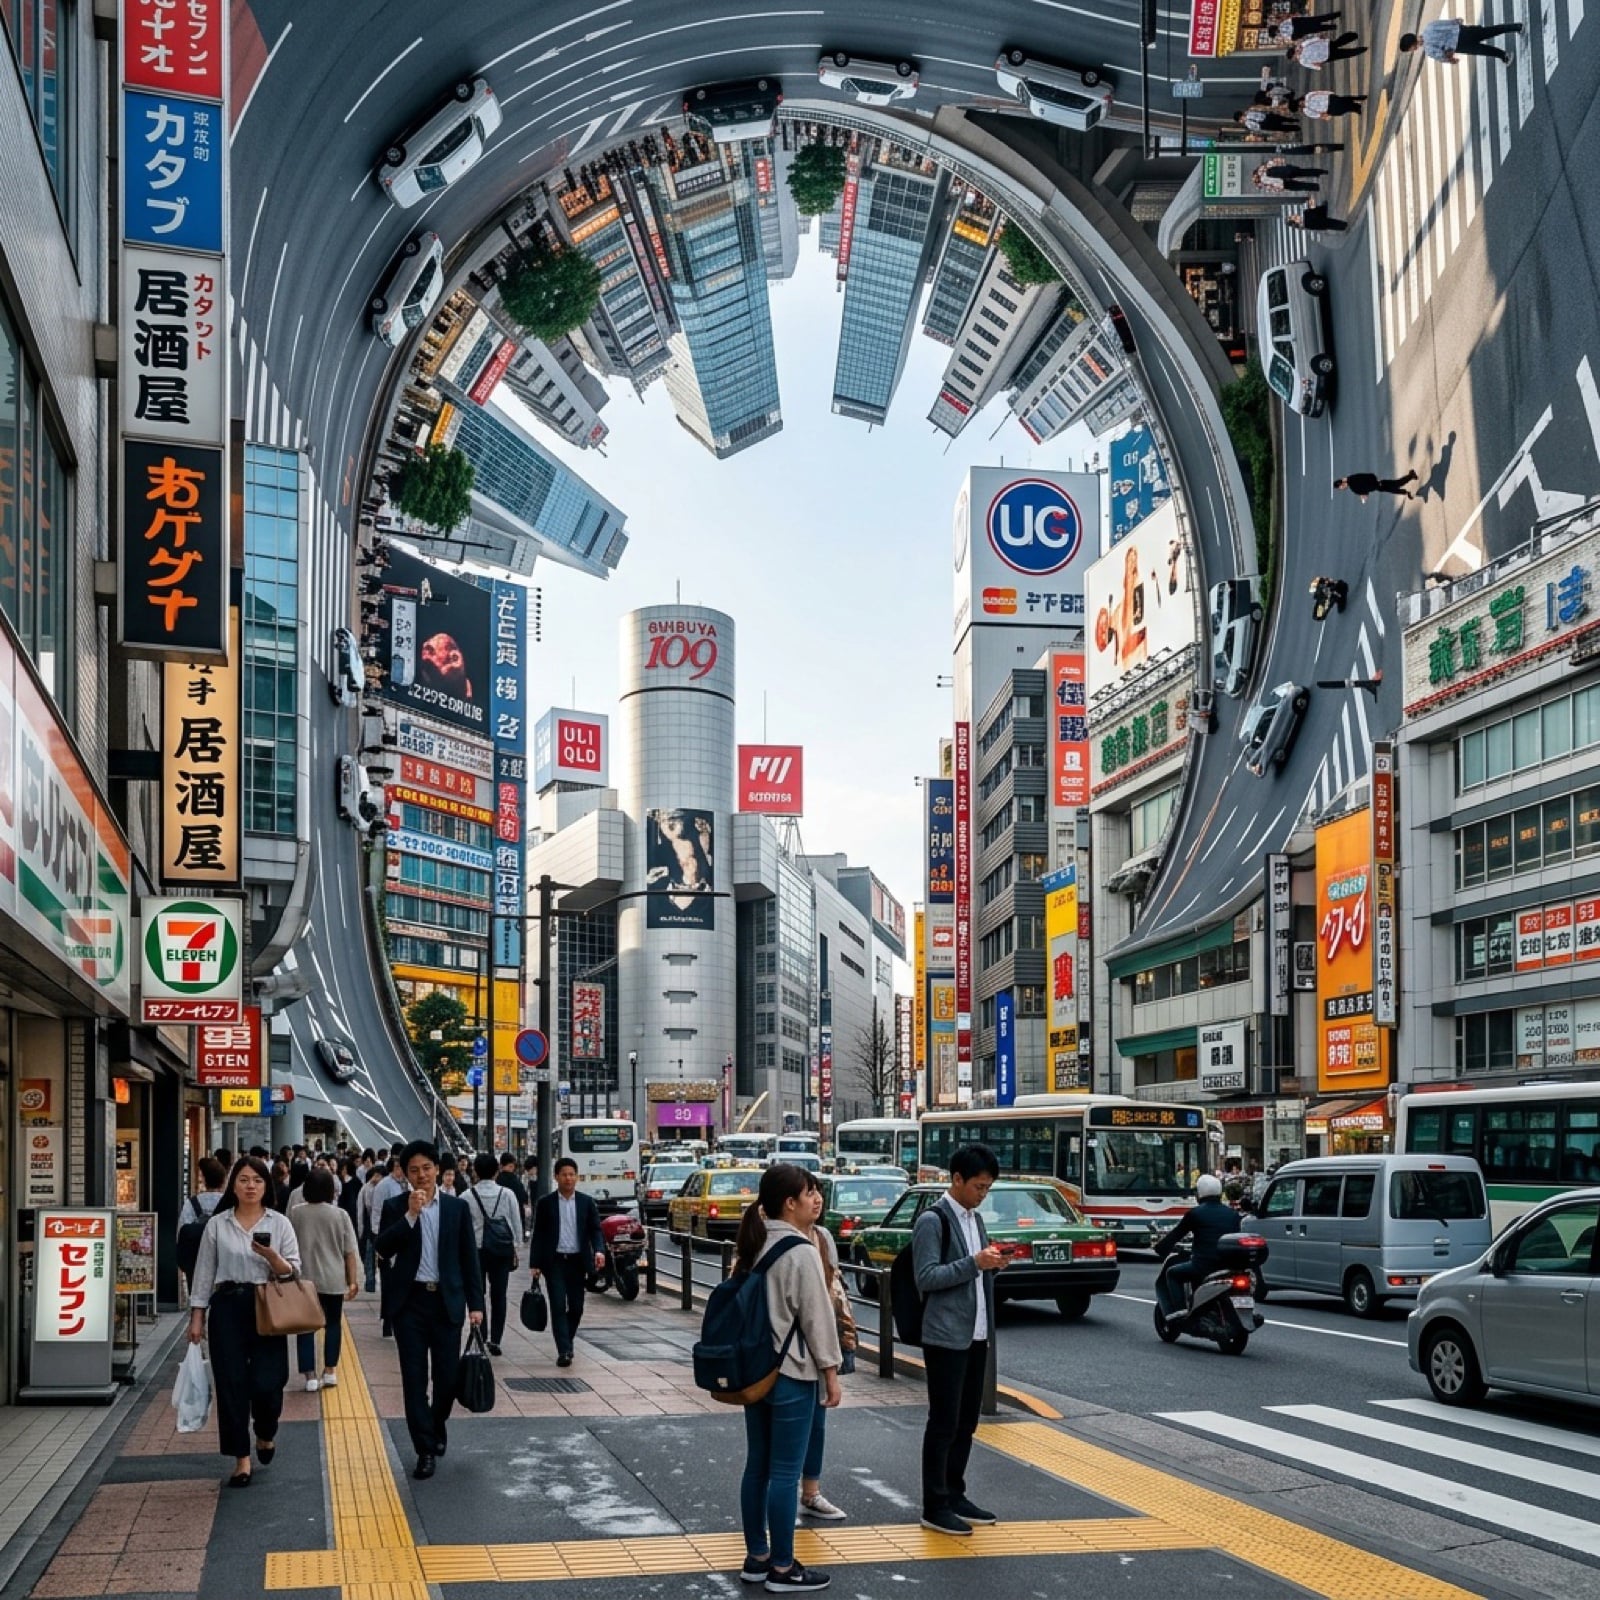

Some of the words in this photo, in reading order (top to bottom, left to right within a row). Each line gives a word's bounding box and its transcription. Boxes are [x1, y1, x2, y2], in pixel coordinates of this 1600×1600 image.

[134, 268, 190, 424] 居酒屋
[1000, 504, 1069, 548] UC
[644, 634, 719, 681] 109
[173, 717, 228, 871] 居酒屋
